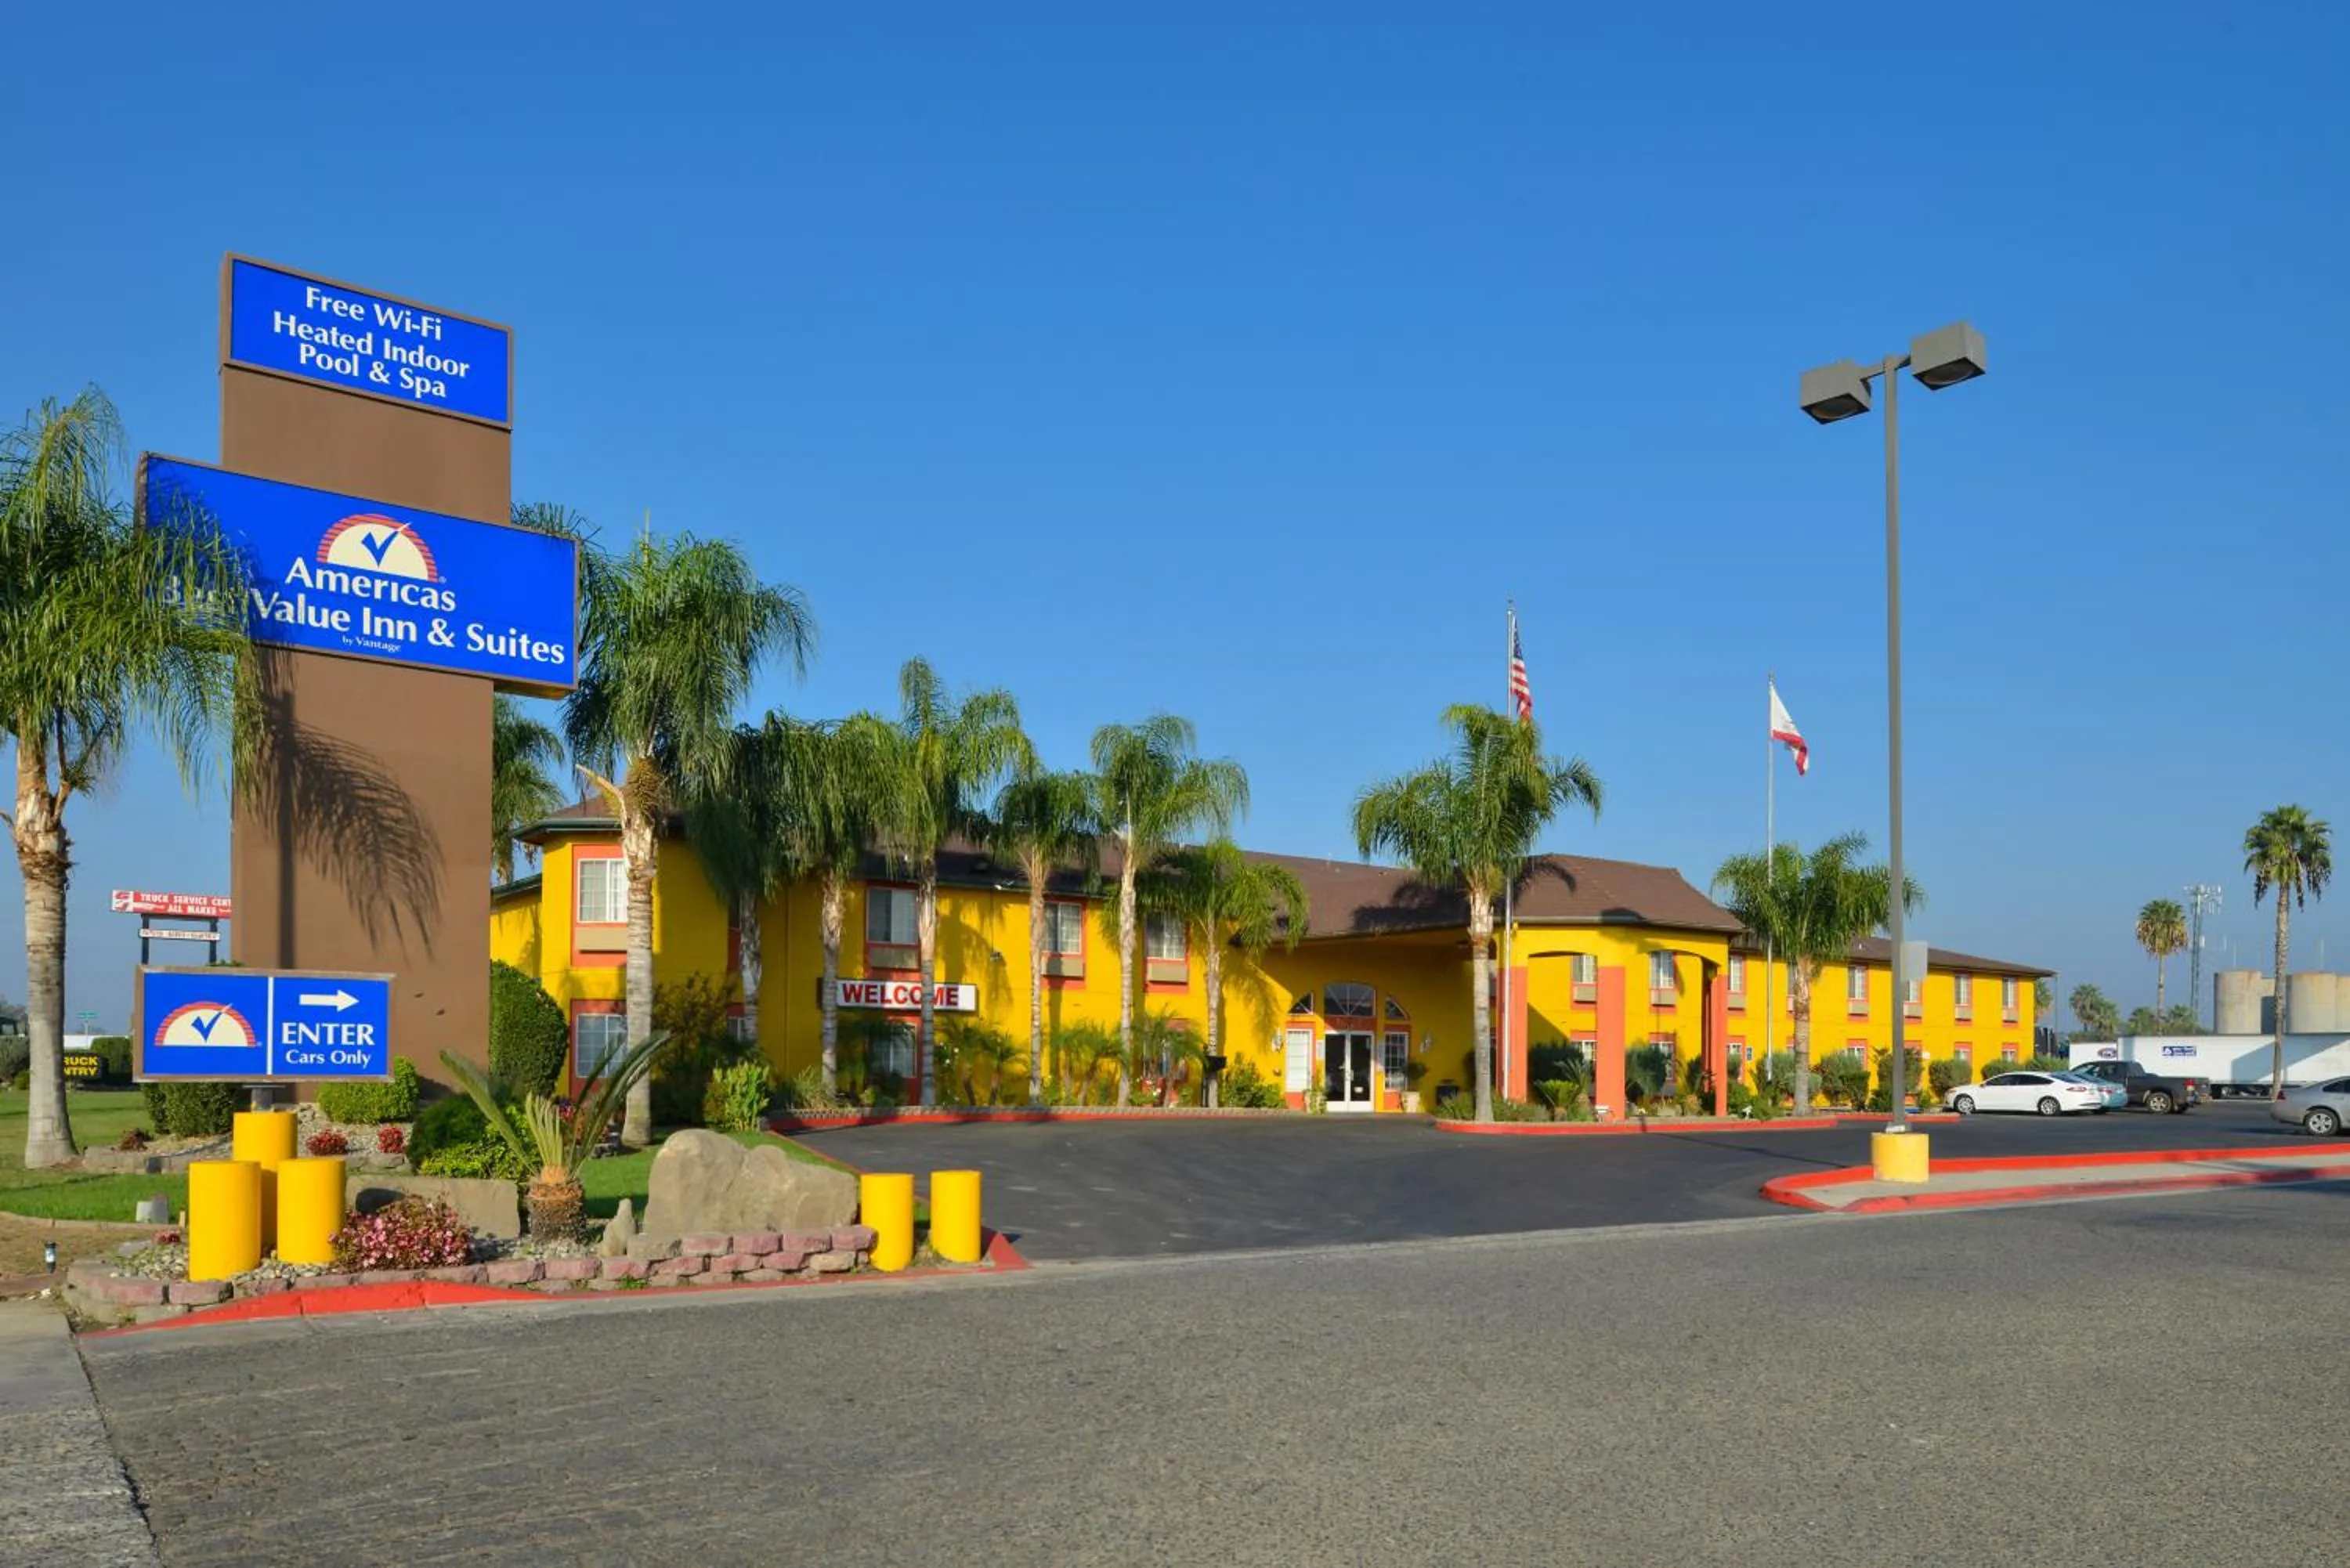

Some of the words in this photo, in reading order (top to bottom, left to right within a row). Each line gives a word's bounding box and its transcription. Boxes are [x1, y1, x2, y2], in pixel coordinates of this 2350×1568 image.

[306, 286, 365, 321] Free
[374, 303, 442, 341] Wi-Fi
[274, 311, 373, 355] Heated
[384, 338, 470, 378] Indoor
[300, 342, 359, 377] Pool
[369, 361, 390, 384] &
[400, 367, 446, 399] Spa
[285, 557, 456, 612] Americas
[250, 588, 351, 632] Value
[363, 607, 418, 642] Inn
[427, 618, 454, 648] &
[466, 623, 565, 664] Suites
[342, 635, 353, 646] by
[355, 636, 402, 654] Vantage
[141, 893, 168, 904] TRUCK
[173, 895, 208, 905] SERVICE
[282, 1022, 374, 1046] ENTER
[285, 1049, 325, 1064] Cars
[330, 1050, 371, 1068] Only
